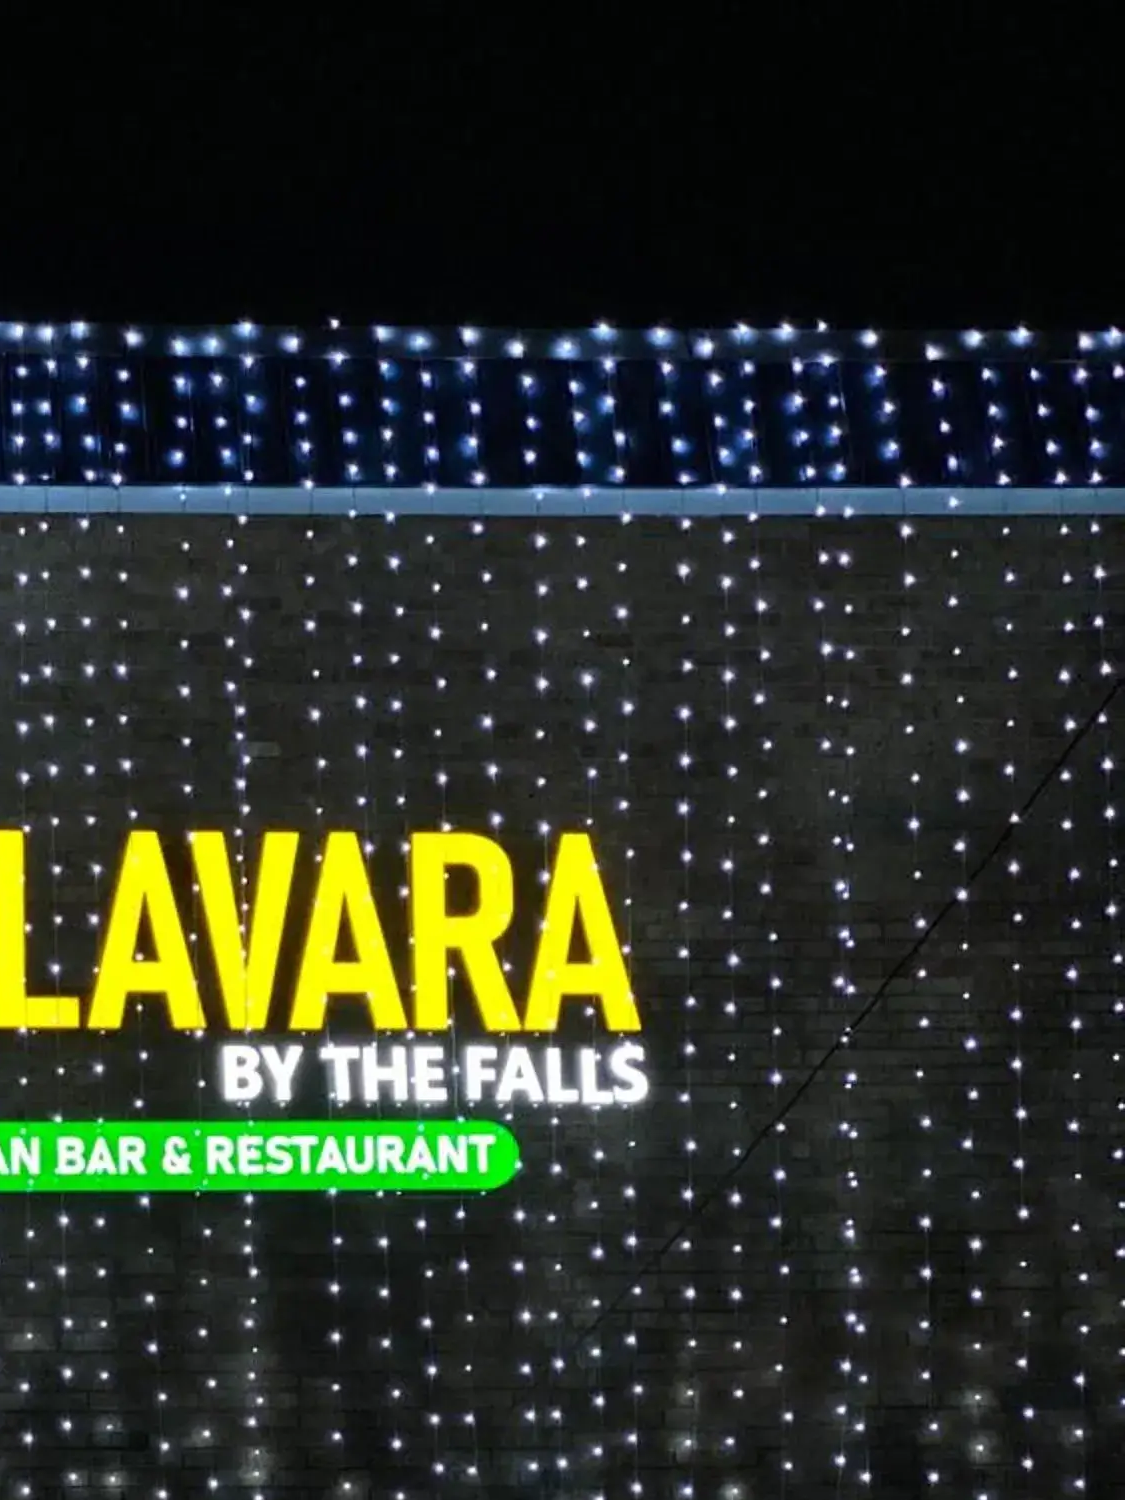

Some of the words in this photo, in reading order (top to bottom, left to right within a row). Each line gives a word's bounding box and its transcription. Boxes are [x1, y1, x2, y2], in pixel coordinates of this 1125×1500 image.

[222, 1043, 294, 1105] BY
[321, 1044, 448, 1105] THE
[465, 1044, 649, 1107] FALLS
[56, 1137, 147, 1176] BAR
[161, 1138, 192, 1177] &
[207, 1136, 497, 1177] RESTAURANT
